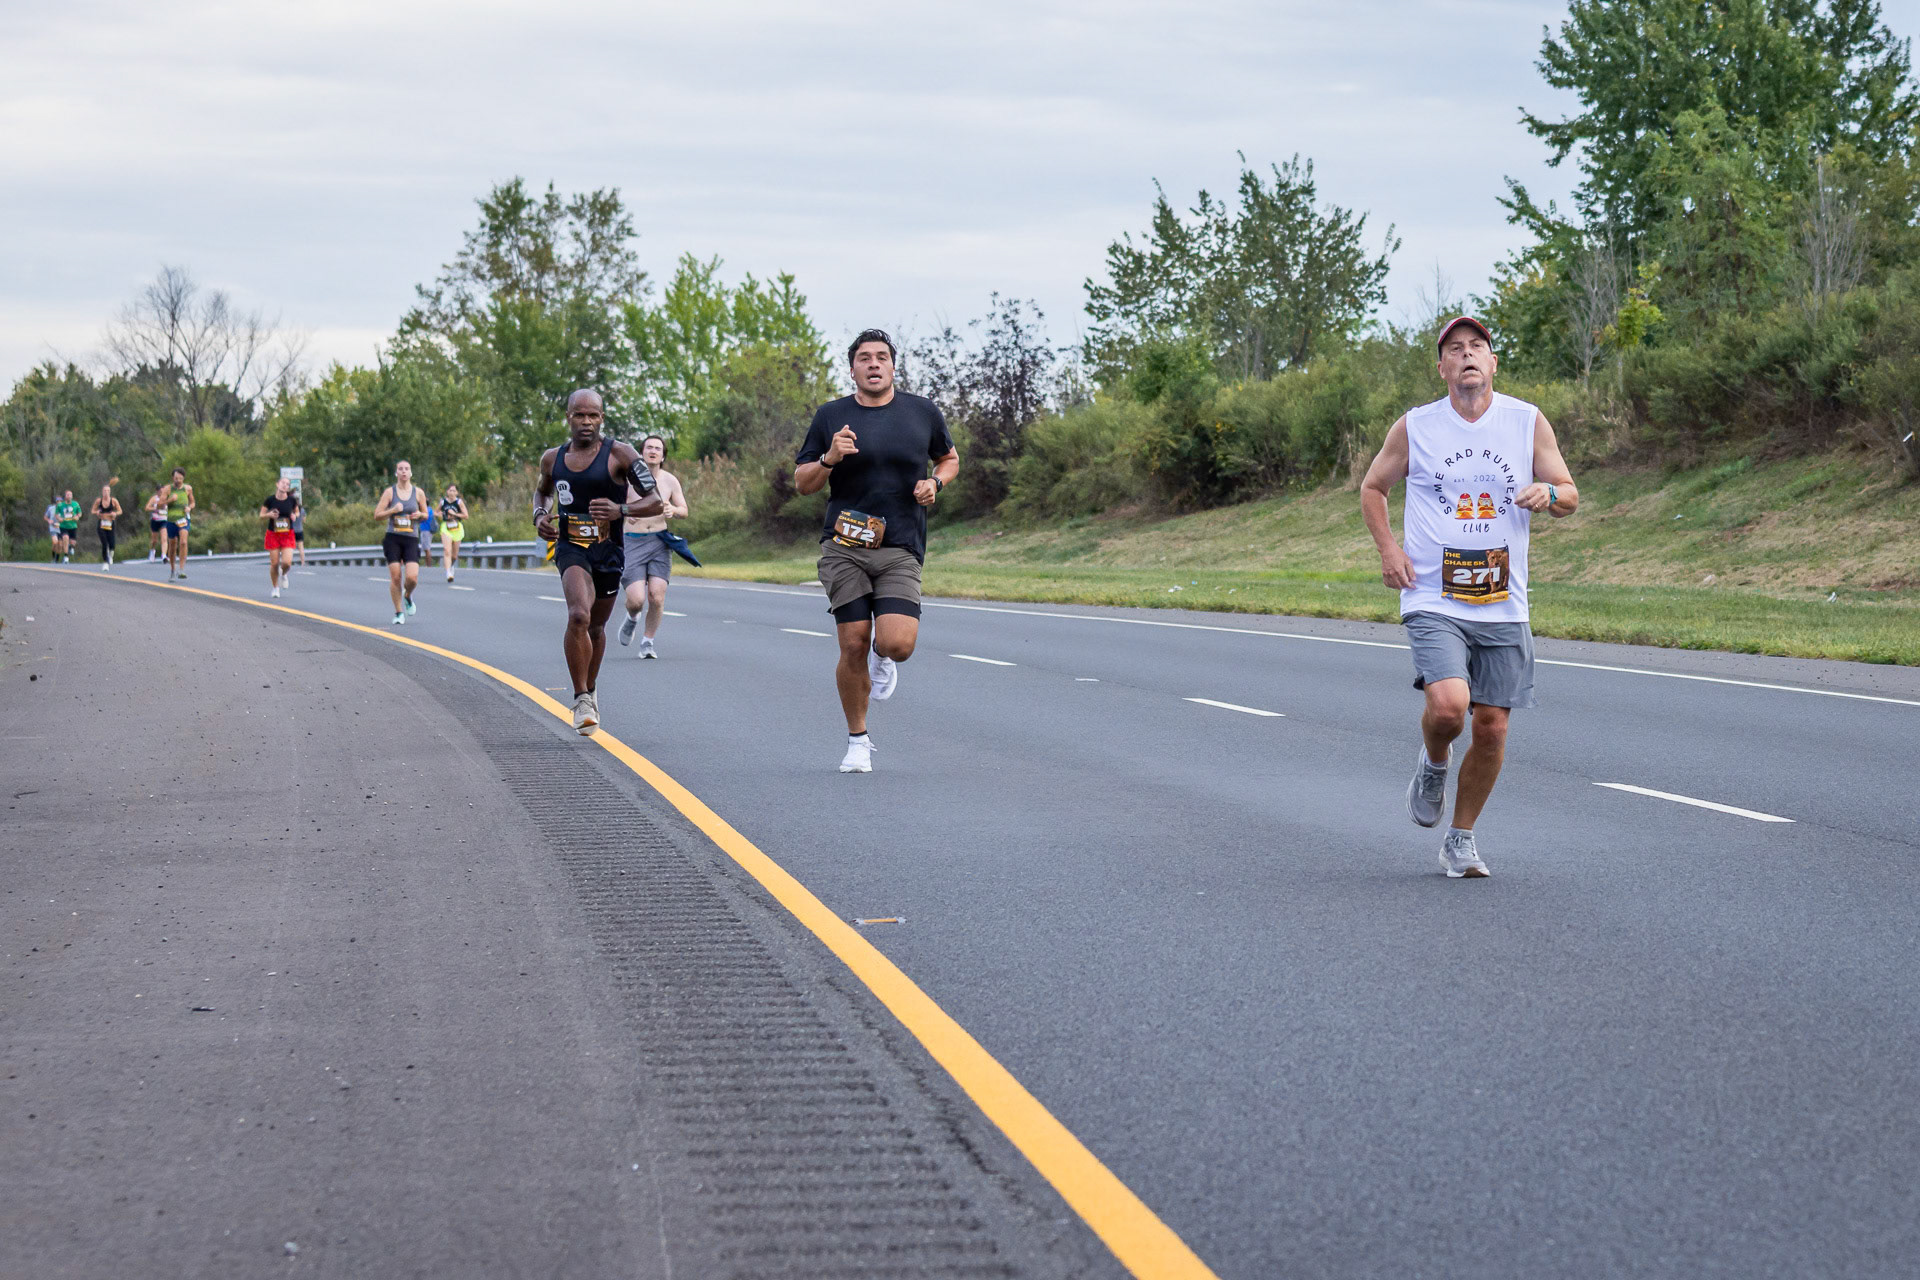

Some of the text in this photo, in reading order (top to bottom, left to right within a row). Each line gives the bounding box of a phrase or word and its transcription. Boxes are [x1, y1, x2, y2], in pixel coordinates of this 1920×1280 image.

[1434, 448, 1514, 515] SOME RAD RUNNERS
[1473, 474, 1496, 482] 2022
[579, 525, 599, 537] 31
[842, 522, 876, 543] 172
[1463, 523, 1490, 532] CLUB
[1444, 551, 1461, 559] THE
[1452, 567, 1500, 584] 271
